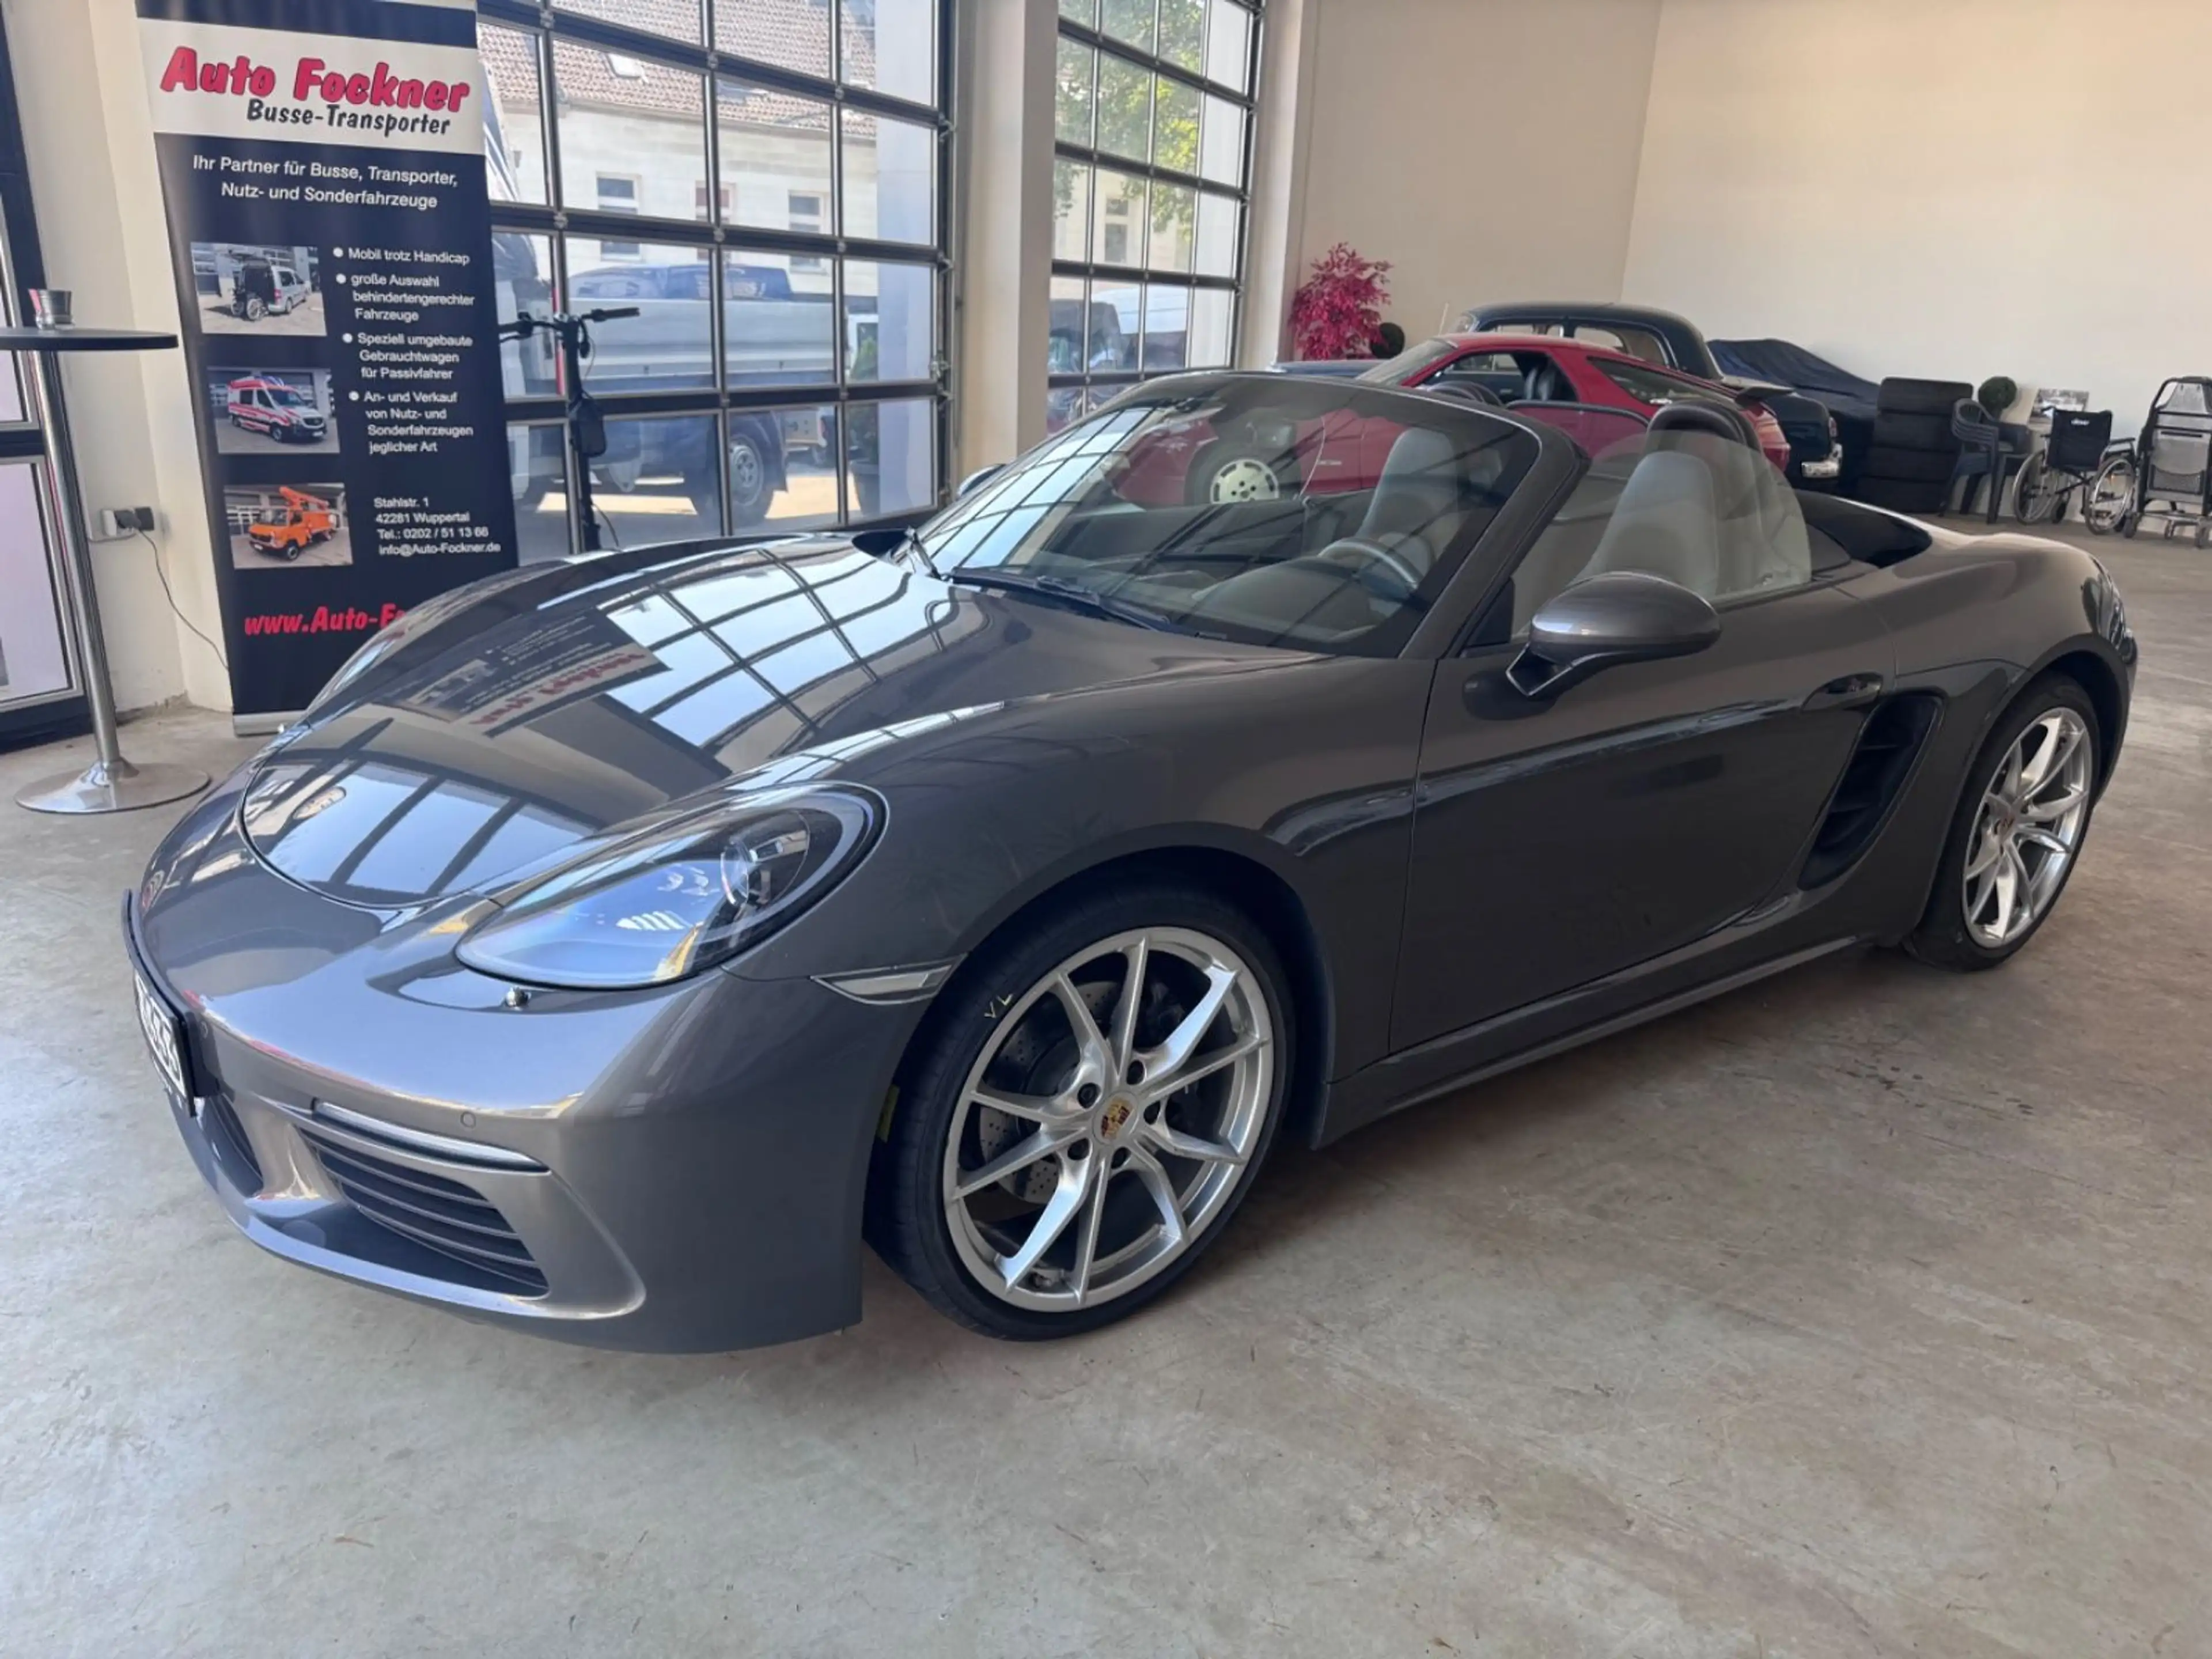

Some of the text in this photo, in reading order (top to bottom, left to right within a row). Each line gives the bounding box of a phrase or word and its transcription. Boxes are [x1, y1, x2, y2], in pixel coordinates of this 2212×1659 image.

[160, 46, 471, 112] Auto Fockner
[246, 99, 450, 137] Busse-Transporter
[193, 155, 458, 187] Ihr Partner für Busse, Transporter,
[221, 182, 437, 210] Nutz- und Sonderfahrzeuge
[349, 247, 471, 266] Mobil trotz Handicap
[351, 273, 440, 287] große Auswahl
[353, 290, 475, 307] behindertengerechter
[354, 308, 419, 323] Fahrzeuge
[358, 332, 473, 347] Speziell umgebaute
[359, 349, 460, 365] Gebrauchtwagen
[361, 366, 453, 379] für Passivfahrer
[363, 391, 458, 403] An- und Verkauf
[365, 408, 447, 419] von Nutz- und
[368, 424, 474, 438] Sonderfahrzeugen
[369, 441, 438, 455] jeglicher Art
[374, 497, 429, 508] Stahlstr. 1
[412, 512, 470, 525] Wuppertal
[403, 528, 431, 539] 0202
